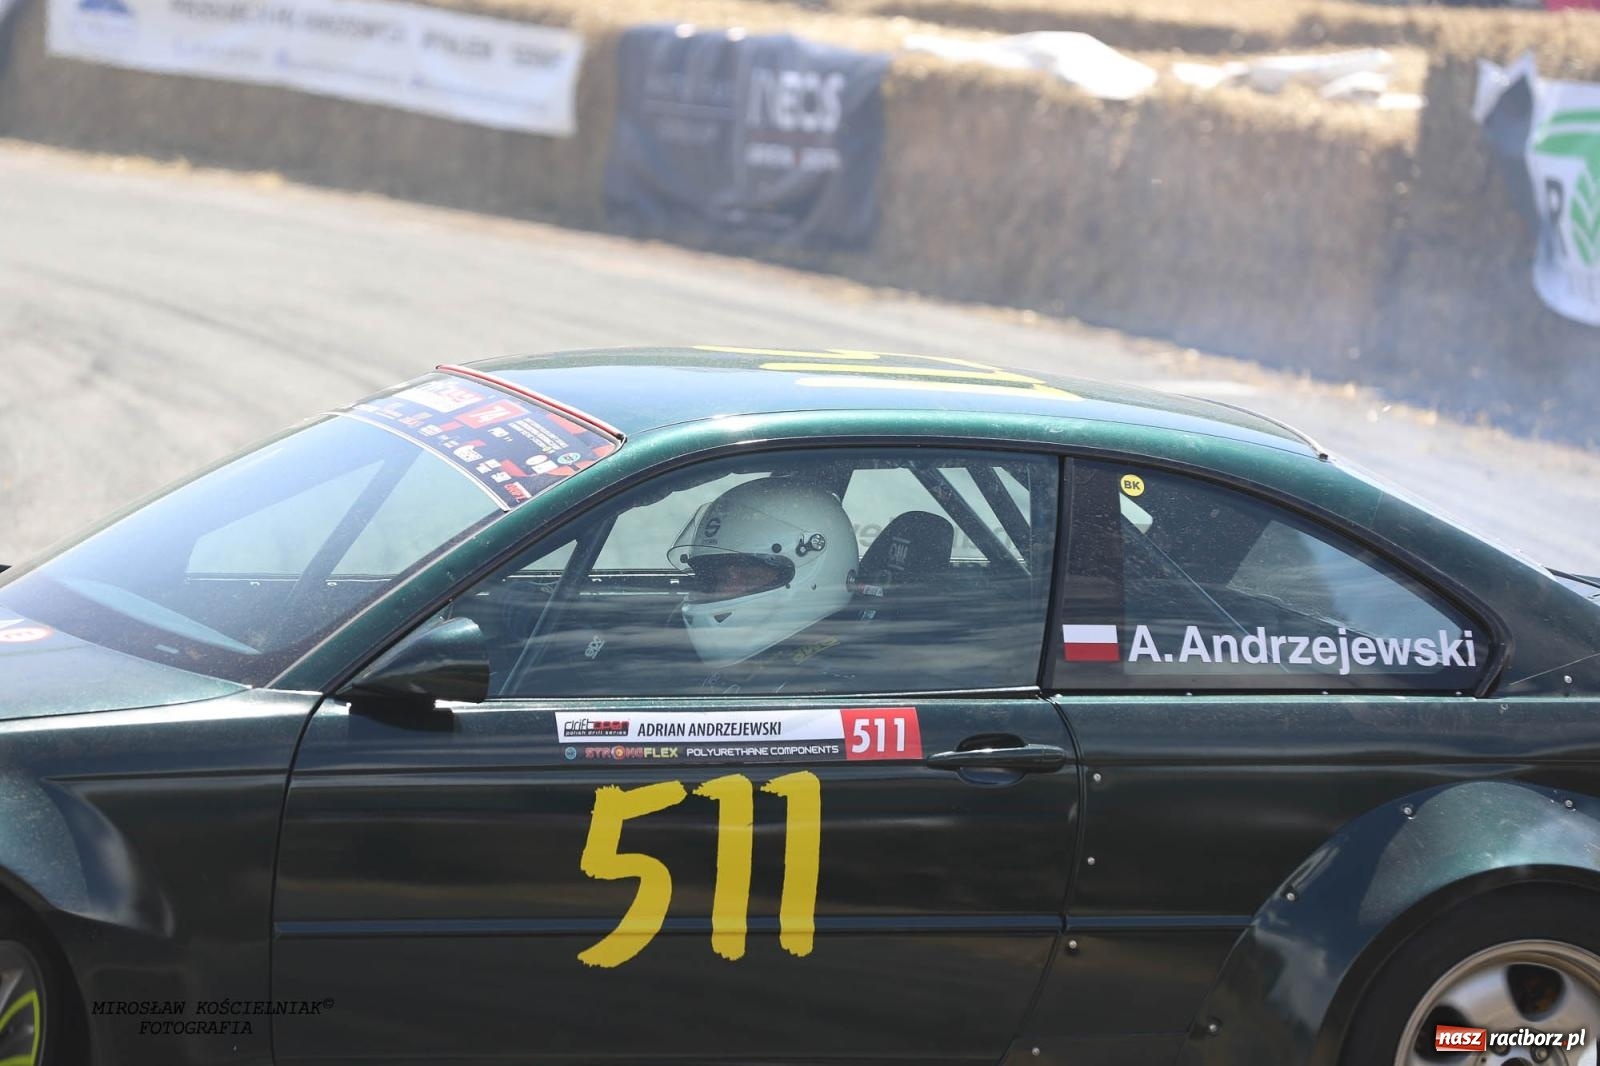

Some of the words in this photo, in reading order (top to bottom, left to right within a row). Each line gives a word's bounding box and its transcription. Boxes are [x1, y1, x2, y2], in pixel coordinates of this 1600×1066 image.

[1123, 480, 1141, 490] BK
[1128, 625, 1477, 675] A.Andrzejewski
[637, 722, 685, 737] ADRIAN
[688, 721, 782, 737] ANDRZEJEWSKI
[851, 717, 905, 753] 511
[686, 746, 769, 757] POLYURETHANE
[770, 745, 839, 756] COMPONENTS
[577, 770, 821, 968] 511
